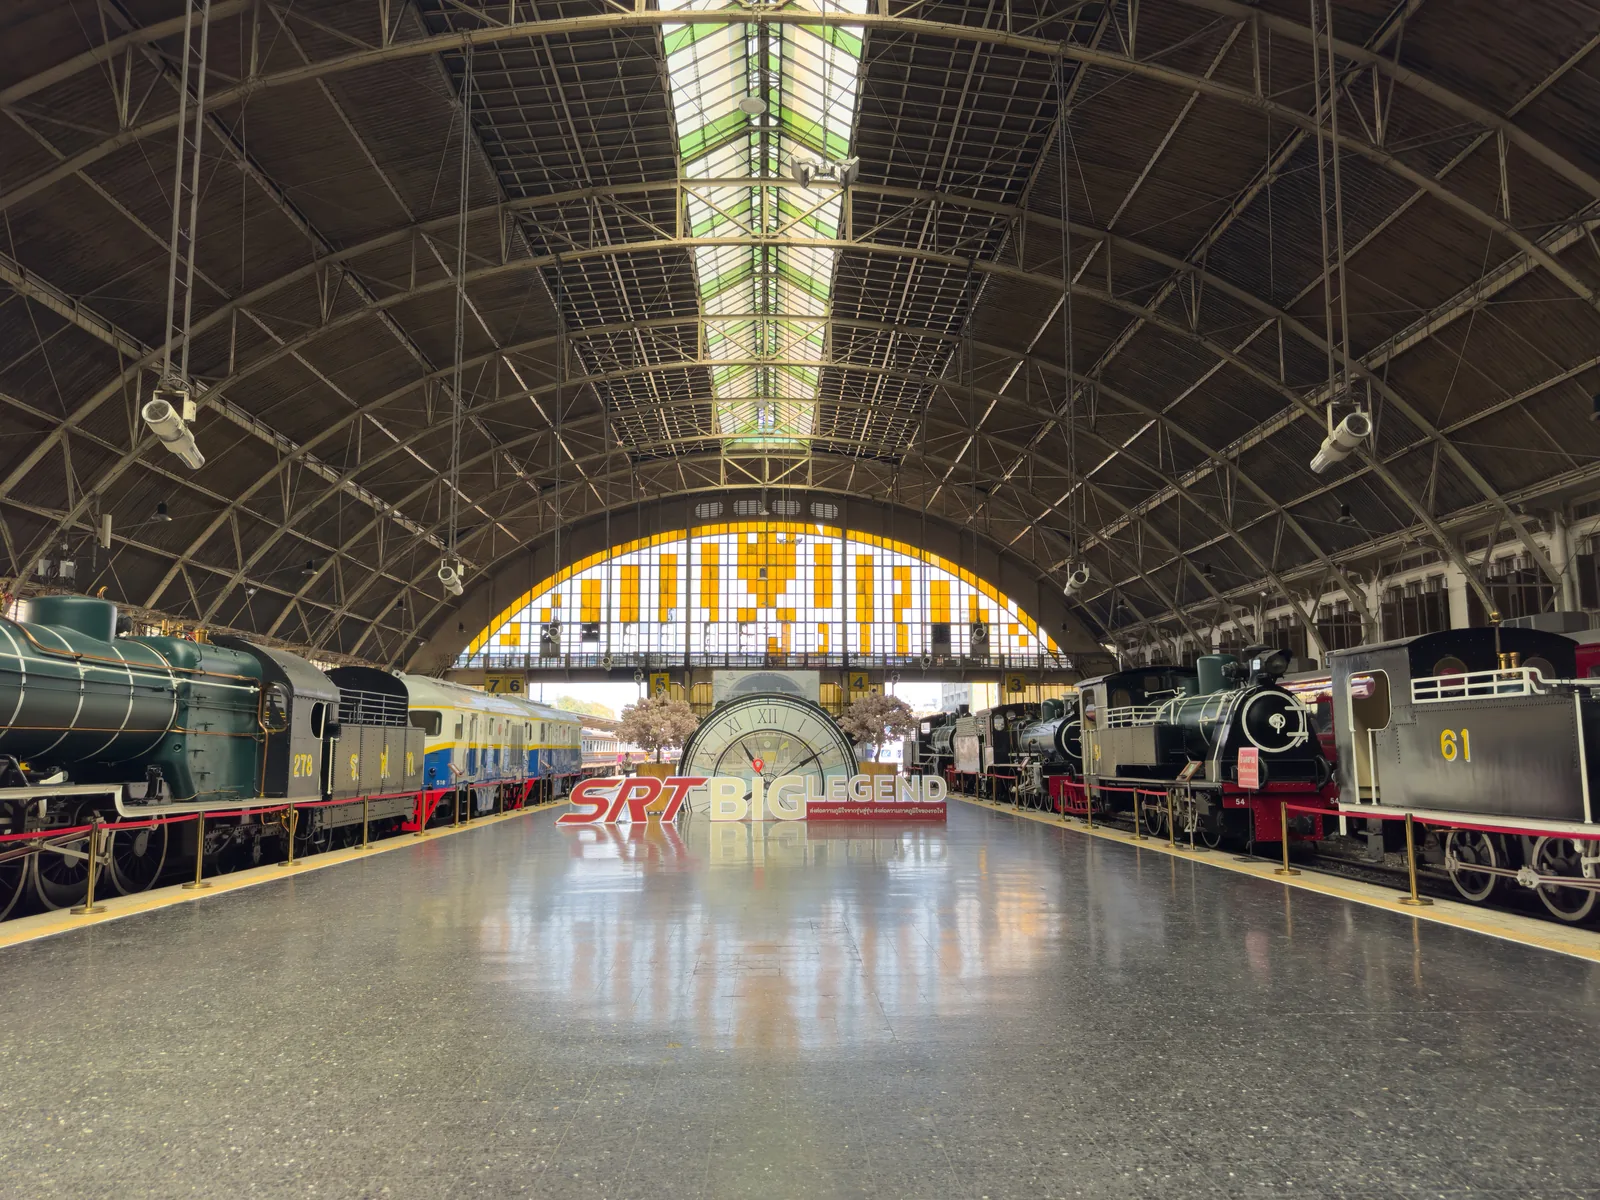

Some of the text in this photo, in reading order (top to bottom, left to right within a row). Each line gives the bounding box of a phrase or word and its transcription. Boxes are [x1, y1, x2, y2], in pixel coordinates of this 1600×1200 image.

[489, 679, 500, 692] 7
[510, 680, 520, 692] 6
[853, 676, 865, 689] 4
[1011, 679, 1021, 692] 3
[757, 708, 778, 724] XII
[723, 716, 743, 736] XI
[797, 718, 807, 733] I
[1440, 728, 1471, 762] 61
[700, 747, 717, 762] X
[293, 753, 313, 778] 278
[555, 774, 947, 825] SRT BIG LEGEND
[1235, 798, 1246, 806] 54
